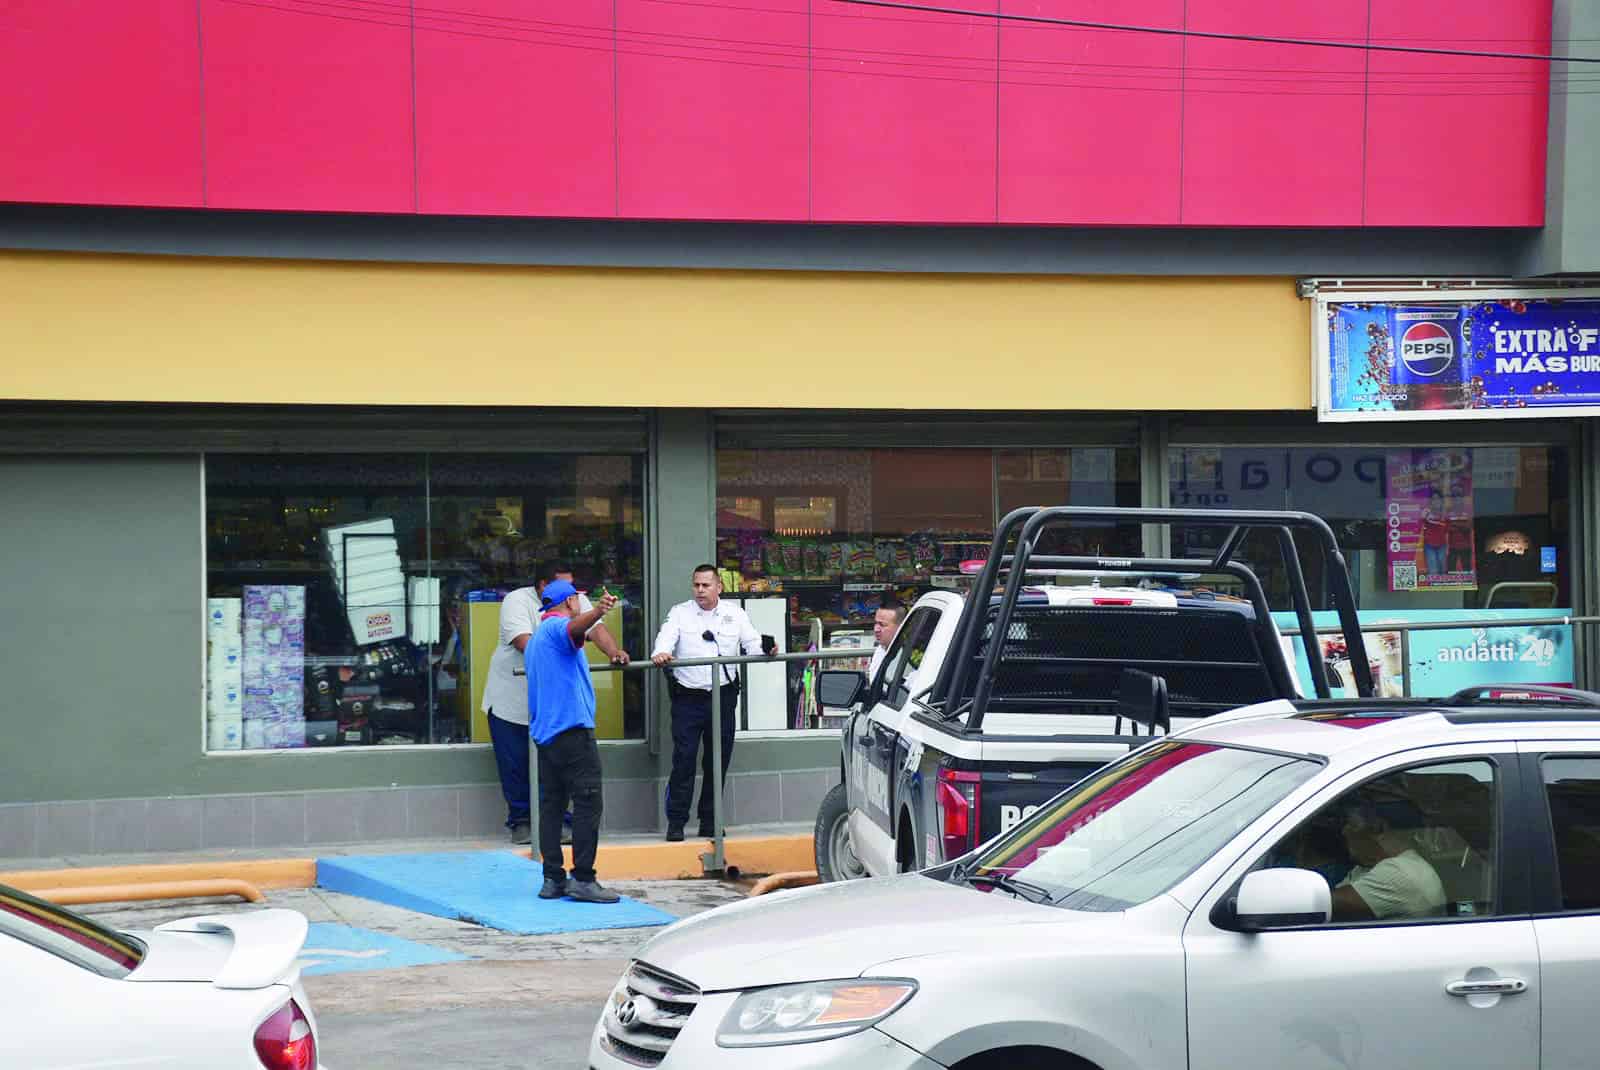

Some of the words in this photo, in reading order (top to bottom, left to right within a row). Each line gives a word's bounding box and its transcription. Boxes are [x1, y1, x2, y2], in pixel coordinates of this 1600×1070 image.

[1404, 343, 1451, 354] PEPSI
[1495, 328, 1568, 353] EXTRA
[1495, 353, 1568, 373] MÁS
[1570, 355, 1600, 372] BUR
[1437, 640, 1515, 662] andatti
